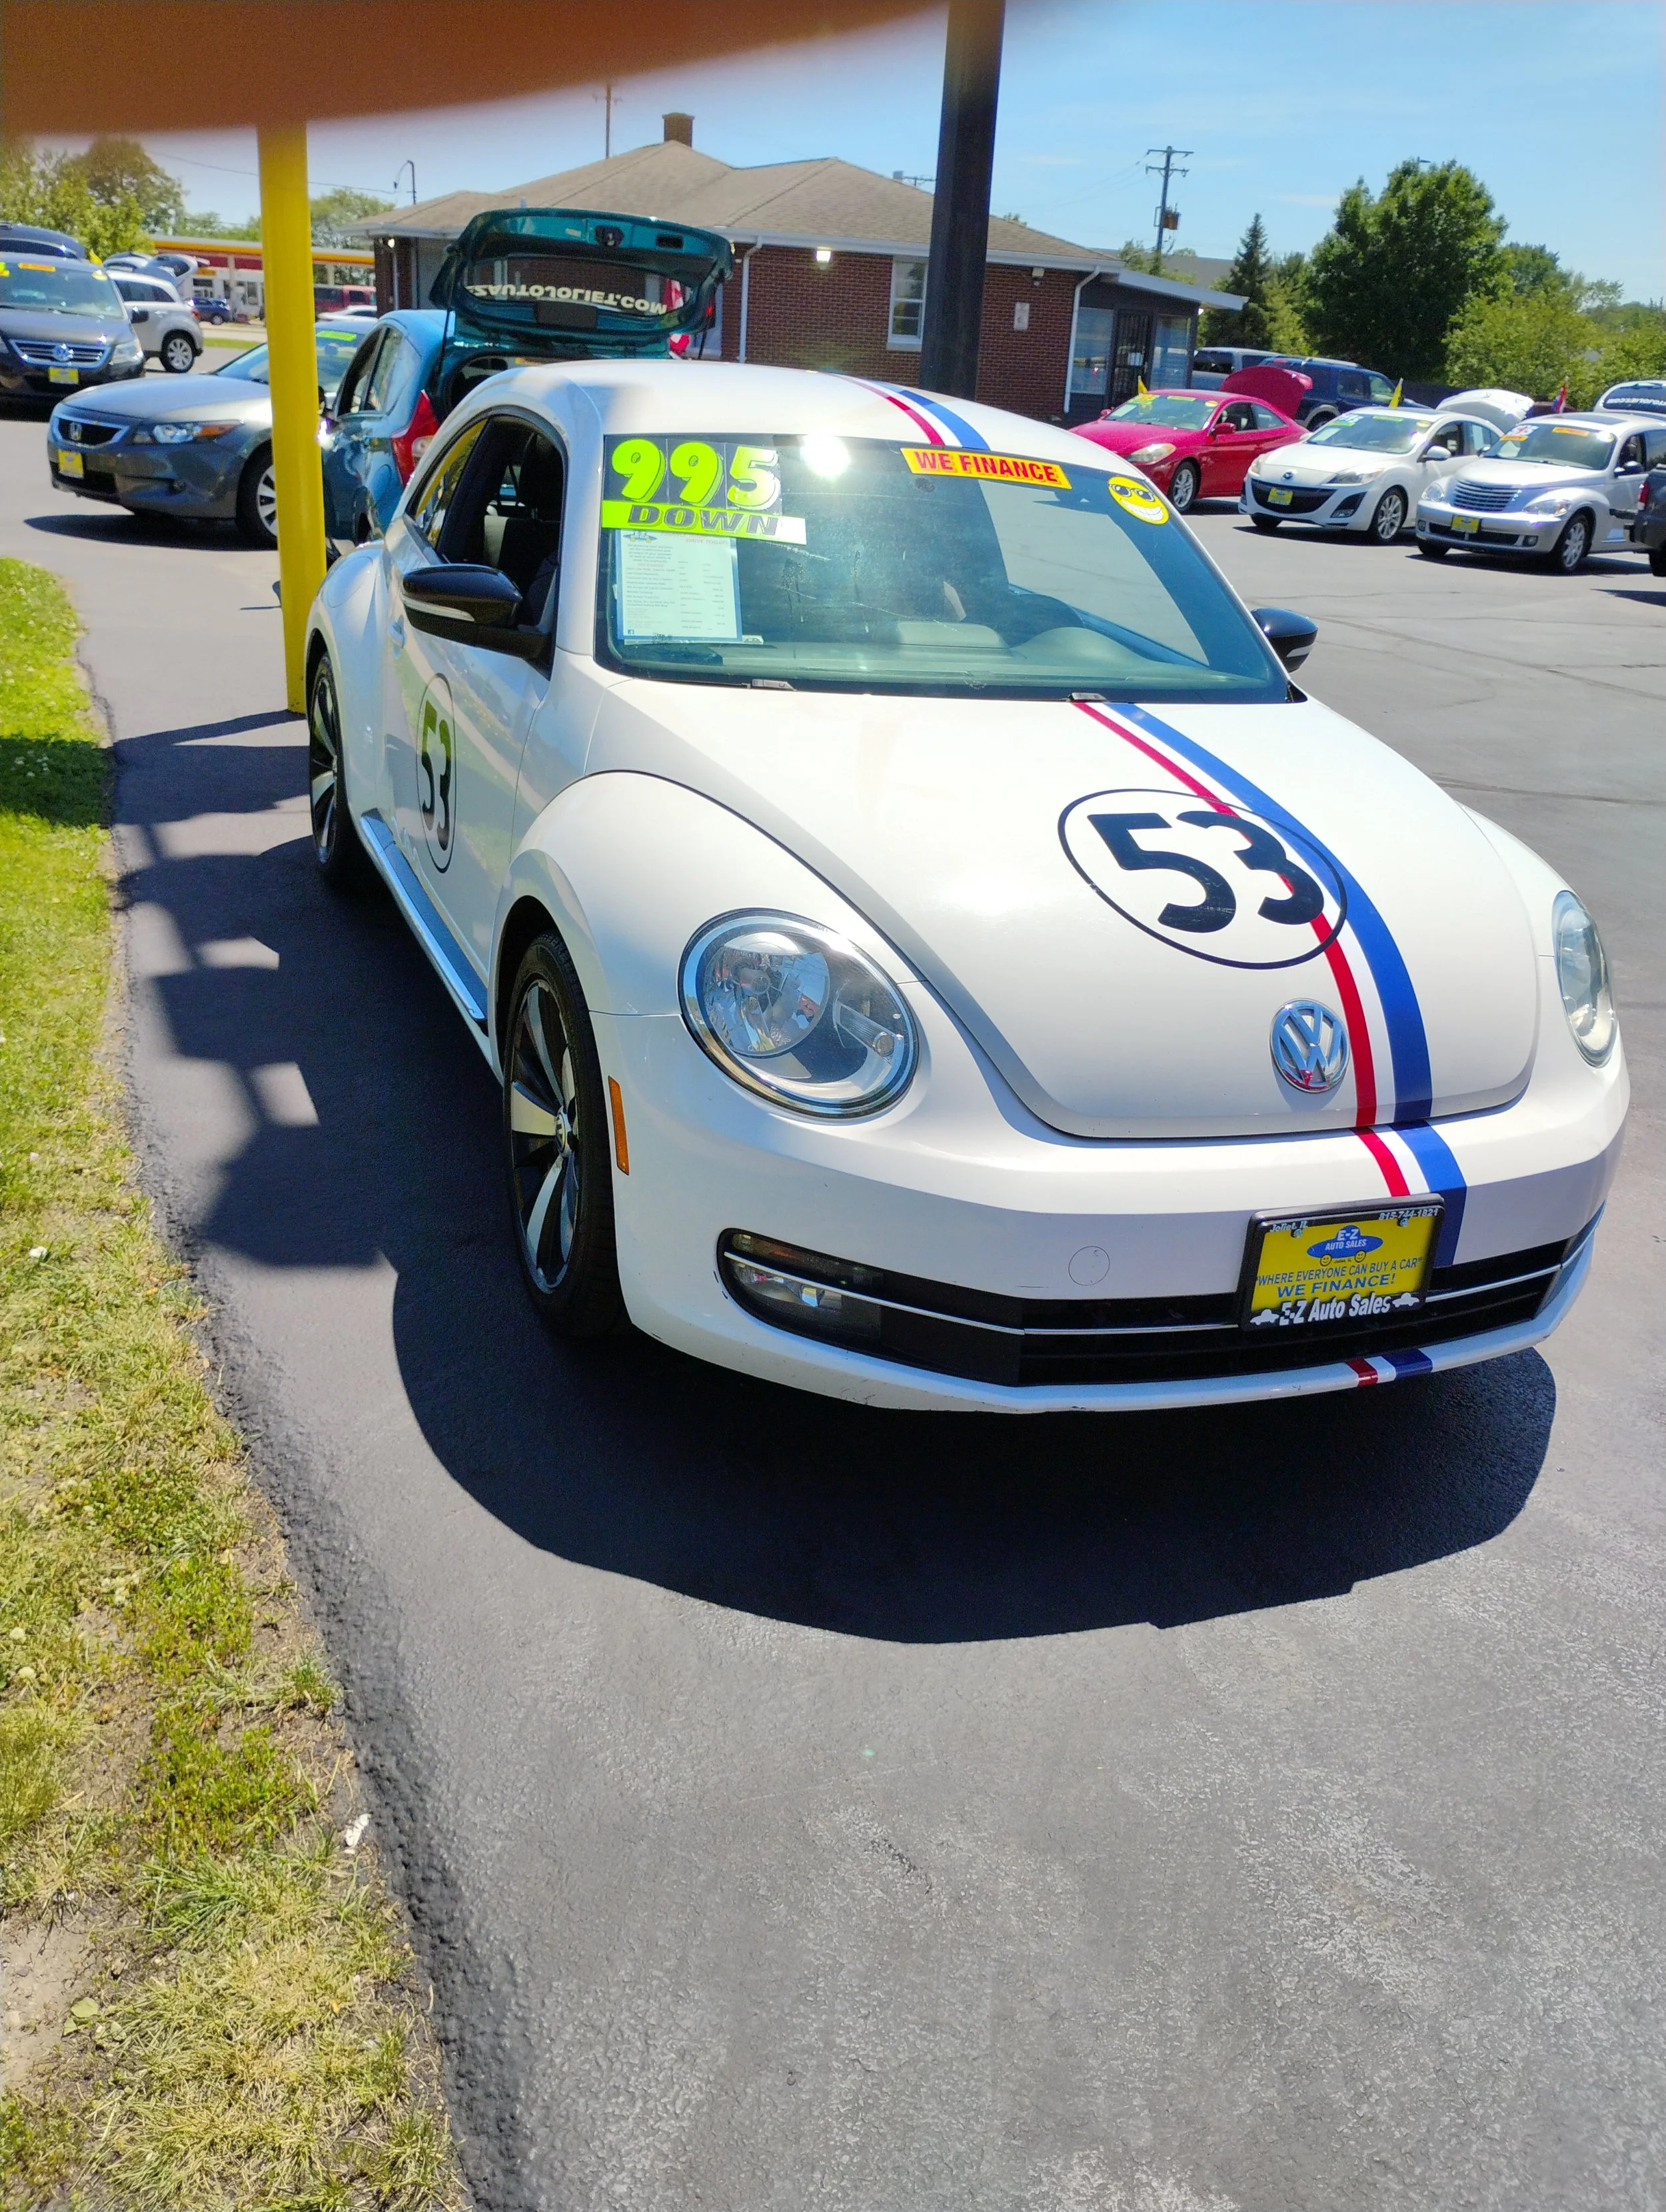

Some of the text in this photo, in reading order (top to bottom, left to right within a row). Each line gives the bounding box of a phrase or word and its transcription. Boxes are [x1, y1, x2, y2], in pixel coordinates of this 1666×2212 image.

[612, 439, 780, 511] 995
[914, 450, 1061, 485] WE FINANCE
[628, 504, 778, 536] DOWN
[421, 700, 451, 851] 53
[1087, 811, 1324, 933] 53
[1379, 1208, 1438, 1220] 815-744-1821
[1325, 1239, 1367, 1251] AUTO SALES
[1337, 1229, 1359, 1241] E-Z
[1277, 1273, 1395, 1297] WE FINANCE!
[1296, 1266, 1346, 1281] EVERYONE
[1349, 1264, 1367, 1276] CAN
[1369, 1261, 1389, 1273] BUY
[1391, 1260, 1397, 1271] A
[1279, 1293, 1391, 1326] E-Z Auto Sales
